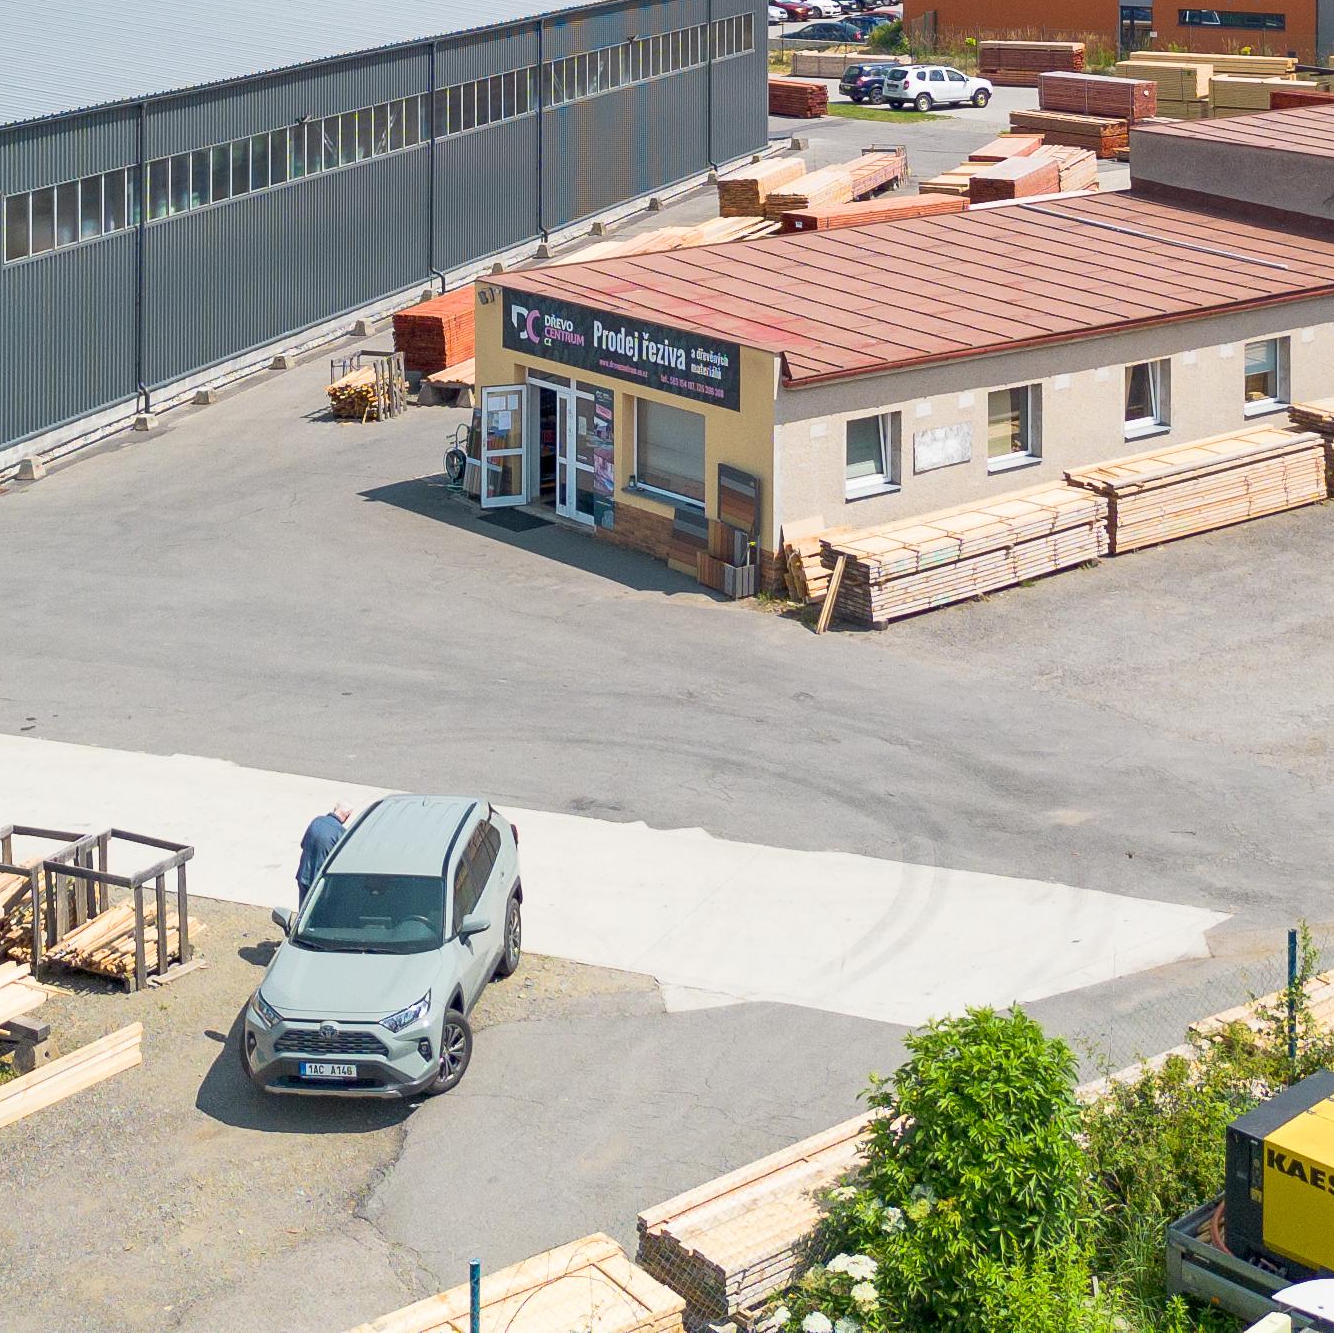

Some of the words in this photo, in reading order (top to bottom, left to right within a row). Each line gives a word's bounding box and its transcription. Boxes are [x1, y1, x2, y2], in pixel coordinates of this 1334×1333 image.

[544, 313, 573, 332] DŘEVO
[544, 327, 585, 346] CENTRUM
[544, 337, 552, 346] CZ
[593, 320, 639, 362] Prodej
[642, 332, 686, 370] řeziva
[690, 348, 696, 358] a
[308, 1065, 324, 1074] 1AC
